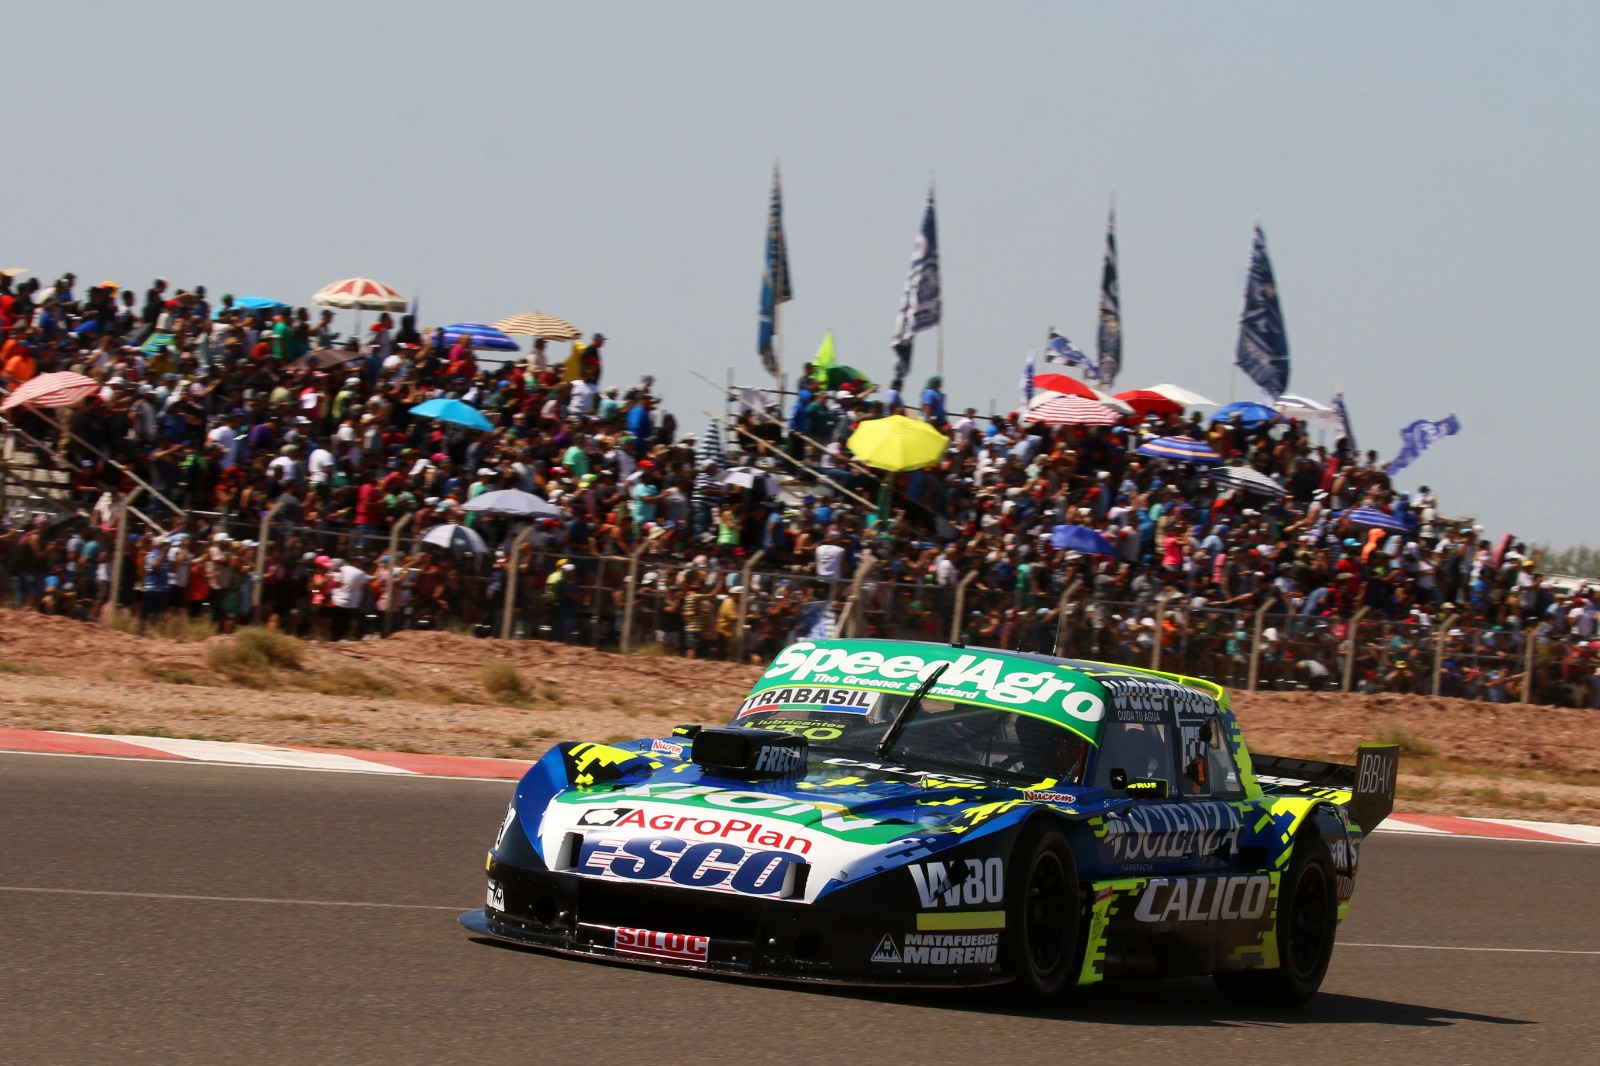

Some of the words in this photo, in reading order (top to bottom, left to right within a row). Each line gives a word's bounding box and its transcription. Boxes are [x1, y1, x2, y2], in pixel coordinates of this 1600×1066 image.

[764, 641, 1105, 722] SpeedAgro
[813, 673, 839, 683] The
[842, 675, 905, 689] Greener
[906, 681, 979, 699] Sndard
[748, 688, 872, 710] TRABASIL
[1101, 677, 1216, 728] waterplus
[758, 719, 846, 729] lubricantes
[1024, 790, 1076, 803] Nucrem
[578, 833, 807, 895] ESCO
[1134, 875, 1271, 923] CALICO
[904, 933, 999, 947] MATAFUEGOS
[903, 946, 998, 965] MORENO
